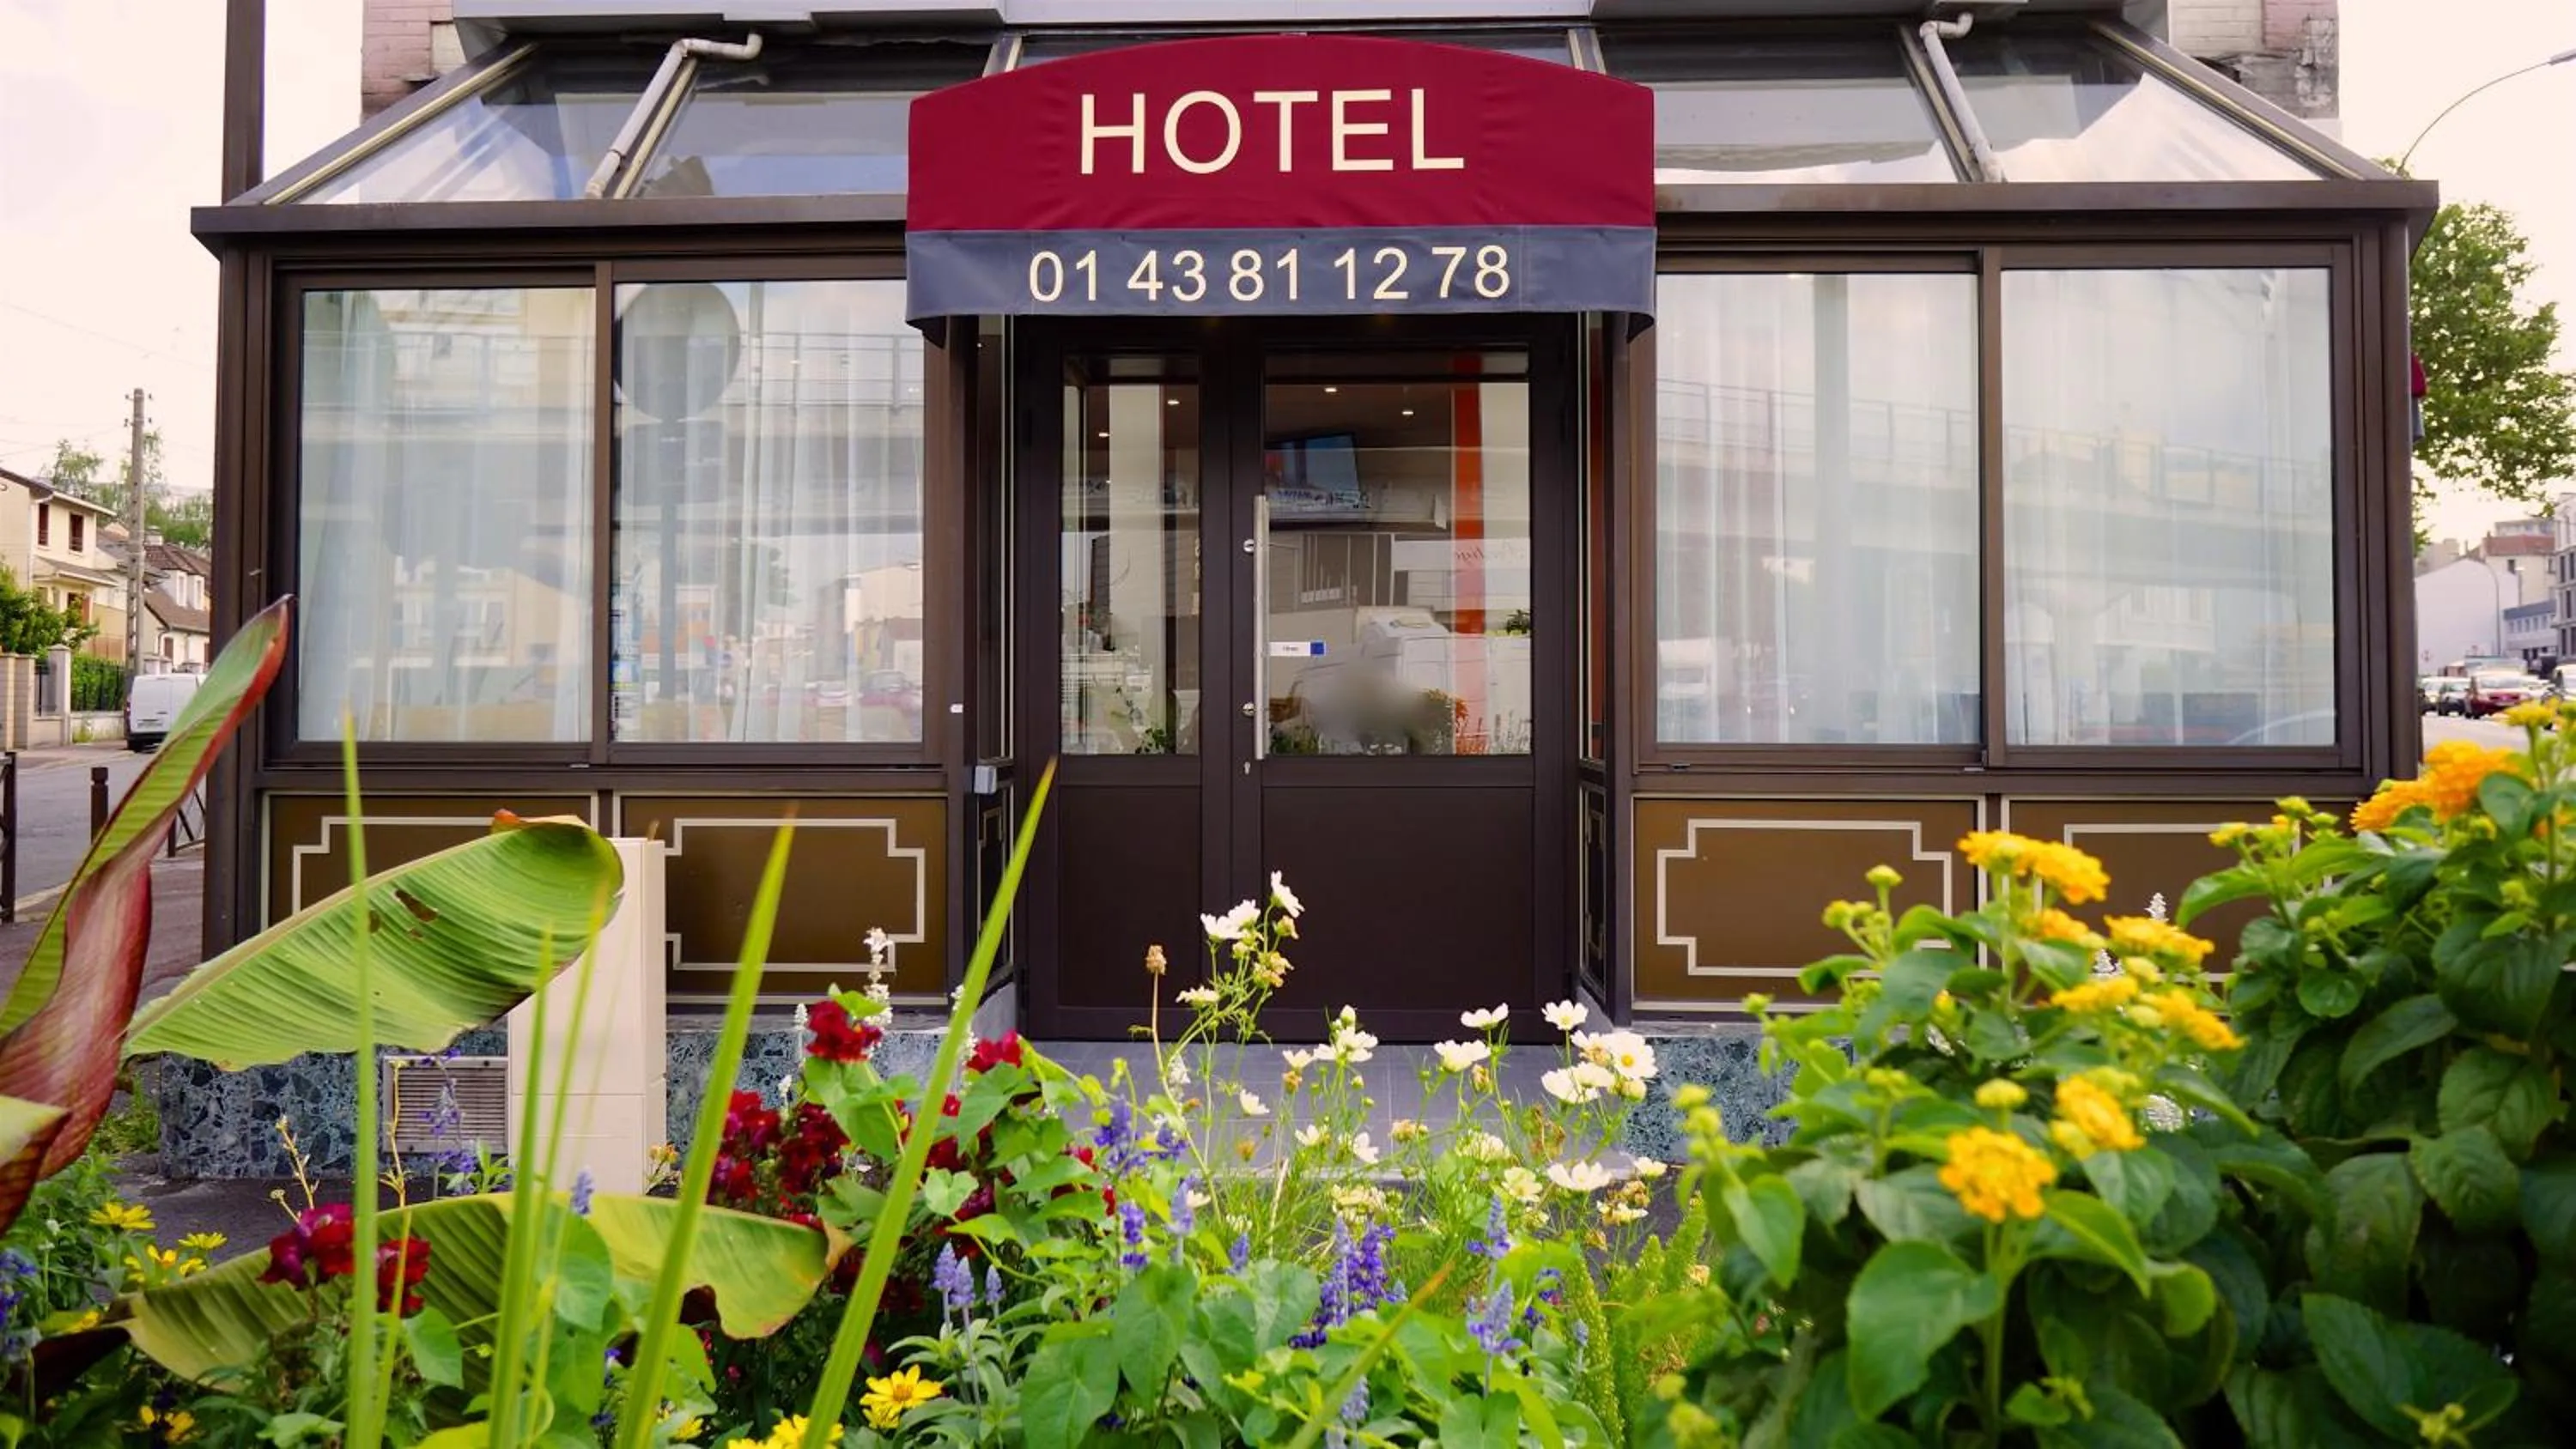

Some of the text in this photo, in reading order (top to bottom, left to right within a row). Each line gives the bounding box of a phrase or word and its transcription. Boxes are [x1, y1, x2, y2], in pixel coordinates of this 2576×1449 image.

[1079, 88, 1465, 175] HOTEL
[1028, 245, 1511, 303] 01 43 81 12 78
